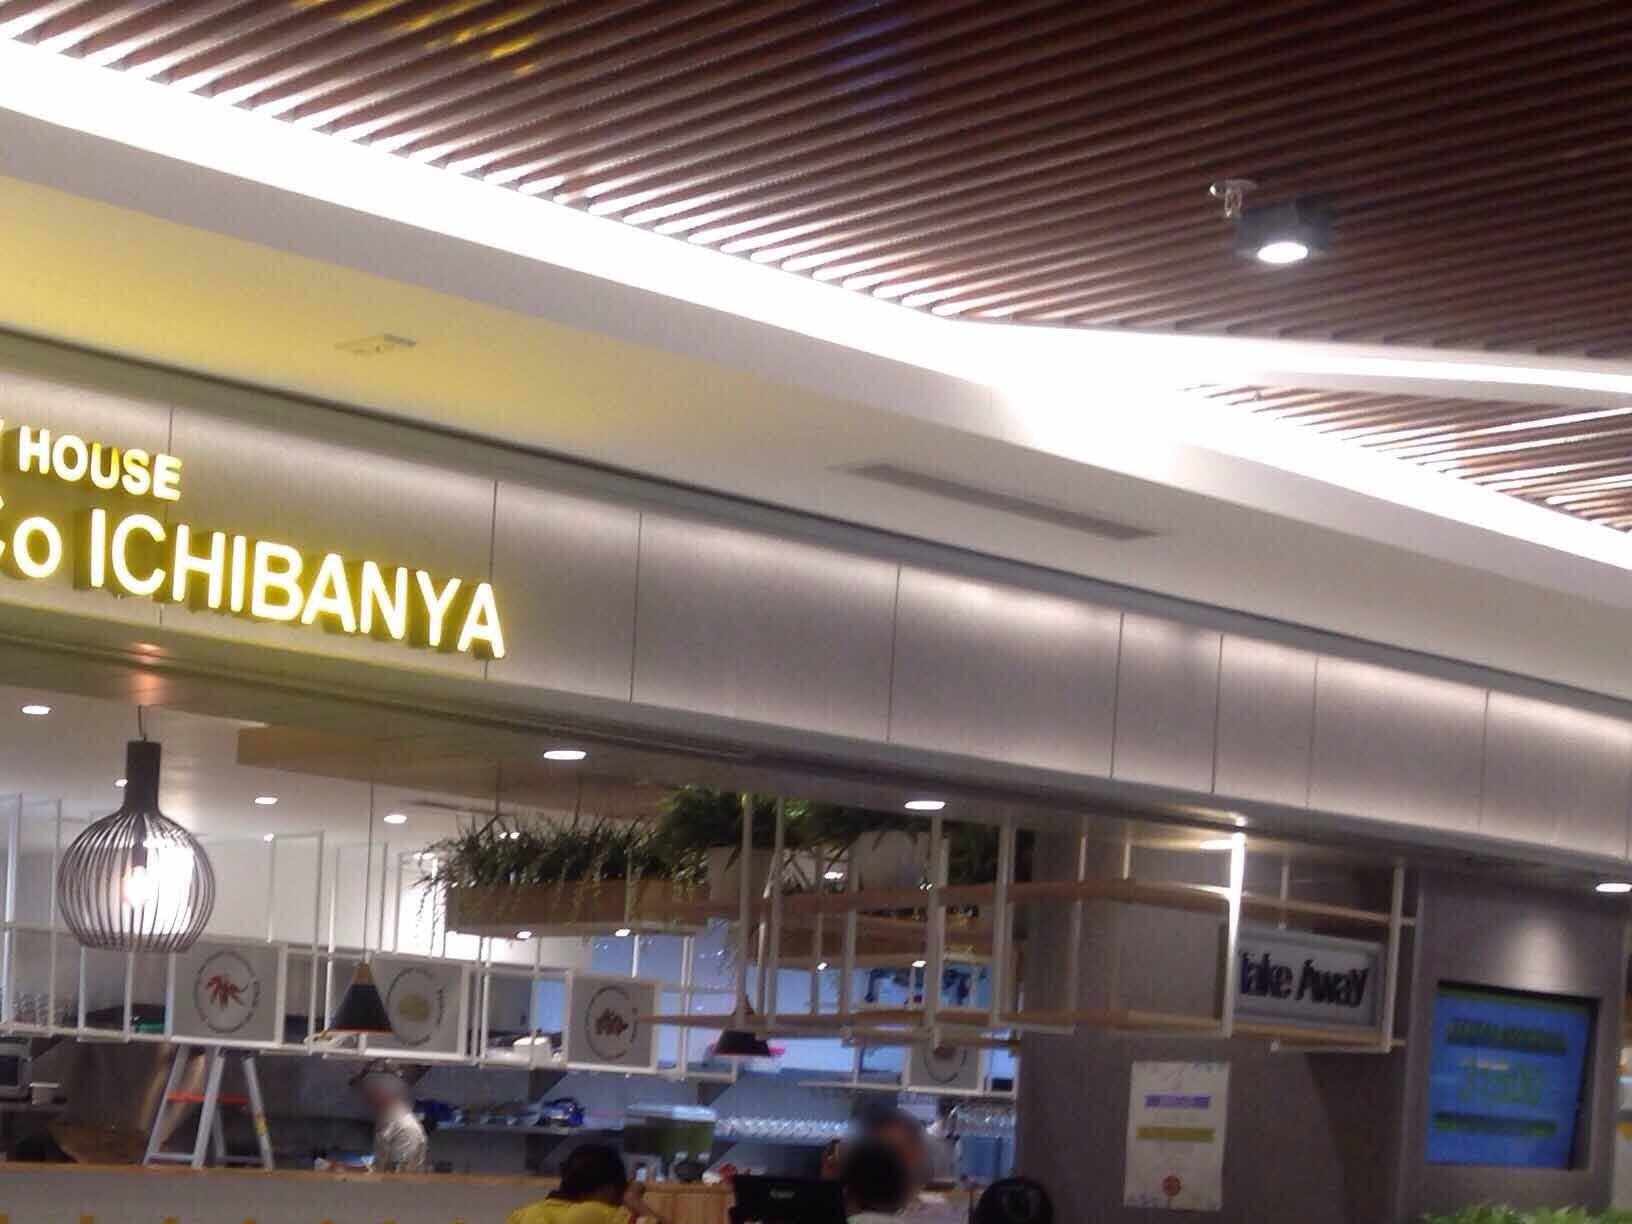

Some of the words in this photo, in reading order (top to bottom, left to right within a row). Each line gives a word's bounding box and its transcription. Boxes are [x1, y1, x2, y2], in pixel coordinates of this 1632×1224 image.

[18, 424, 182, 502] HOUSE
[79, 508, 506, 658] ICHIBANYA
[1296, 958, 1369, 1008] Away
